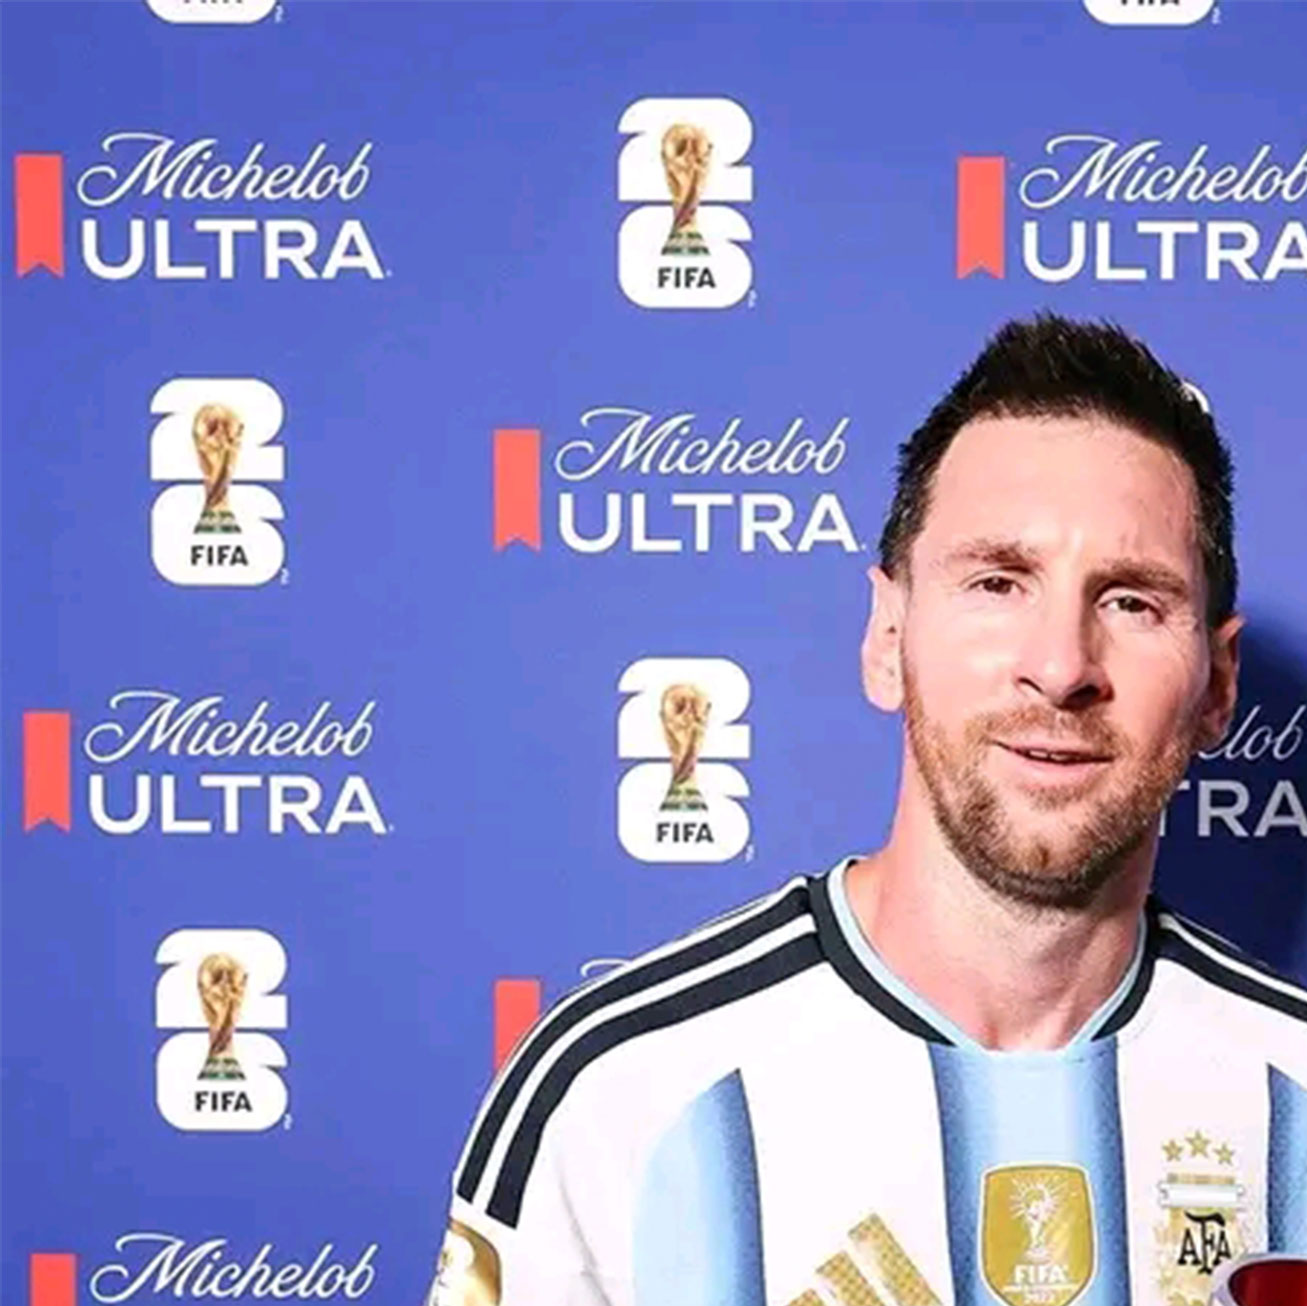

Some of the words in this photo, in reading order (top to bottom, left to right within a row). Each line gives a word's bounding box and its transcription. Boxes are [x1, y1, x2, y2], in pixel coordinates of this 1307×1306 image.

[76, 132, 373, 207] Michelob
[82, 218, 384, 280] ULTRA
[657, 266, 716, 289] FIFA
[554, 407, 850, 481] Michelob
[559, 492, 859, 553] ULTRA
[190, 544, 249, 566] FIFA
[84, 690, 376, 763] Michelob
[89, 774, 387, 835] ULTRA
[656, 822, 715, 843] FIFA
[194, 1090, 253, 1112] FIFA
[90, 1233, 378, 1304] Michelob
[1177, 1210, 1233, 1276] AFA
[1014, 1263, 1069, 1285] FIFA
